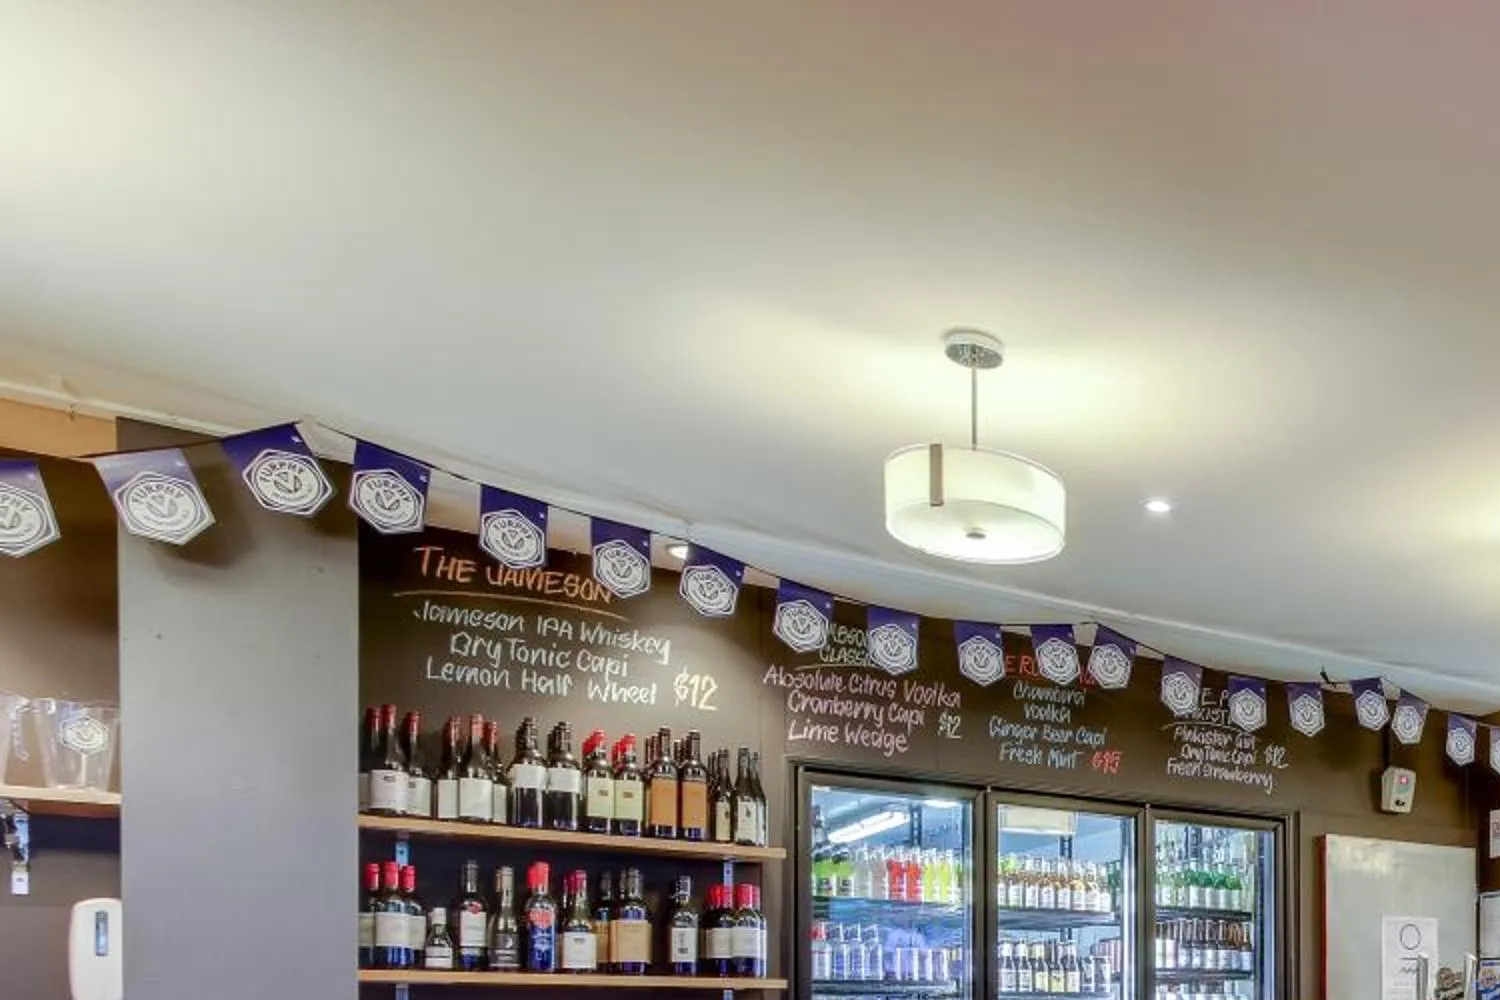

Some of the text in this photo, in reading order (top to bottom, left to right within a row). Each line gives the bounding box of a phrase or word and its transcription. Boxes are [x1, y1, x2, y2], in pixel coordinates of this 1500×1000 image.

[414, 546, 612, 603] THE JAMESON
[413, 600, 671, 665] Jameson IPA Whiskey
[451, 631, 629, 681] Dry Tonic Capi
[426, 655, 718, 711] Lemon Half Wheel $12
[850, 673, 897, 698] Citrus
[903, 679, 961, 709] Vodka
[788, 689, 961, 739] Cranberry Capi $12
[788, 719, 908, 757] Lime Wedge
[999, 742, 1042, 765] Fresh
